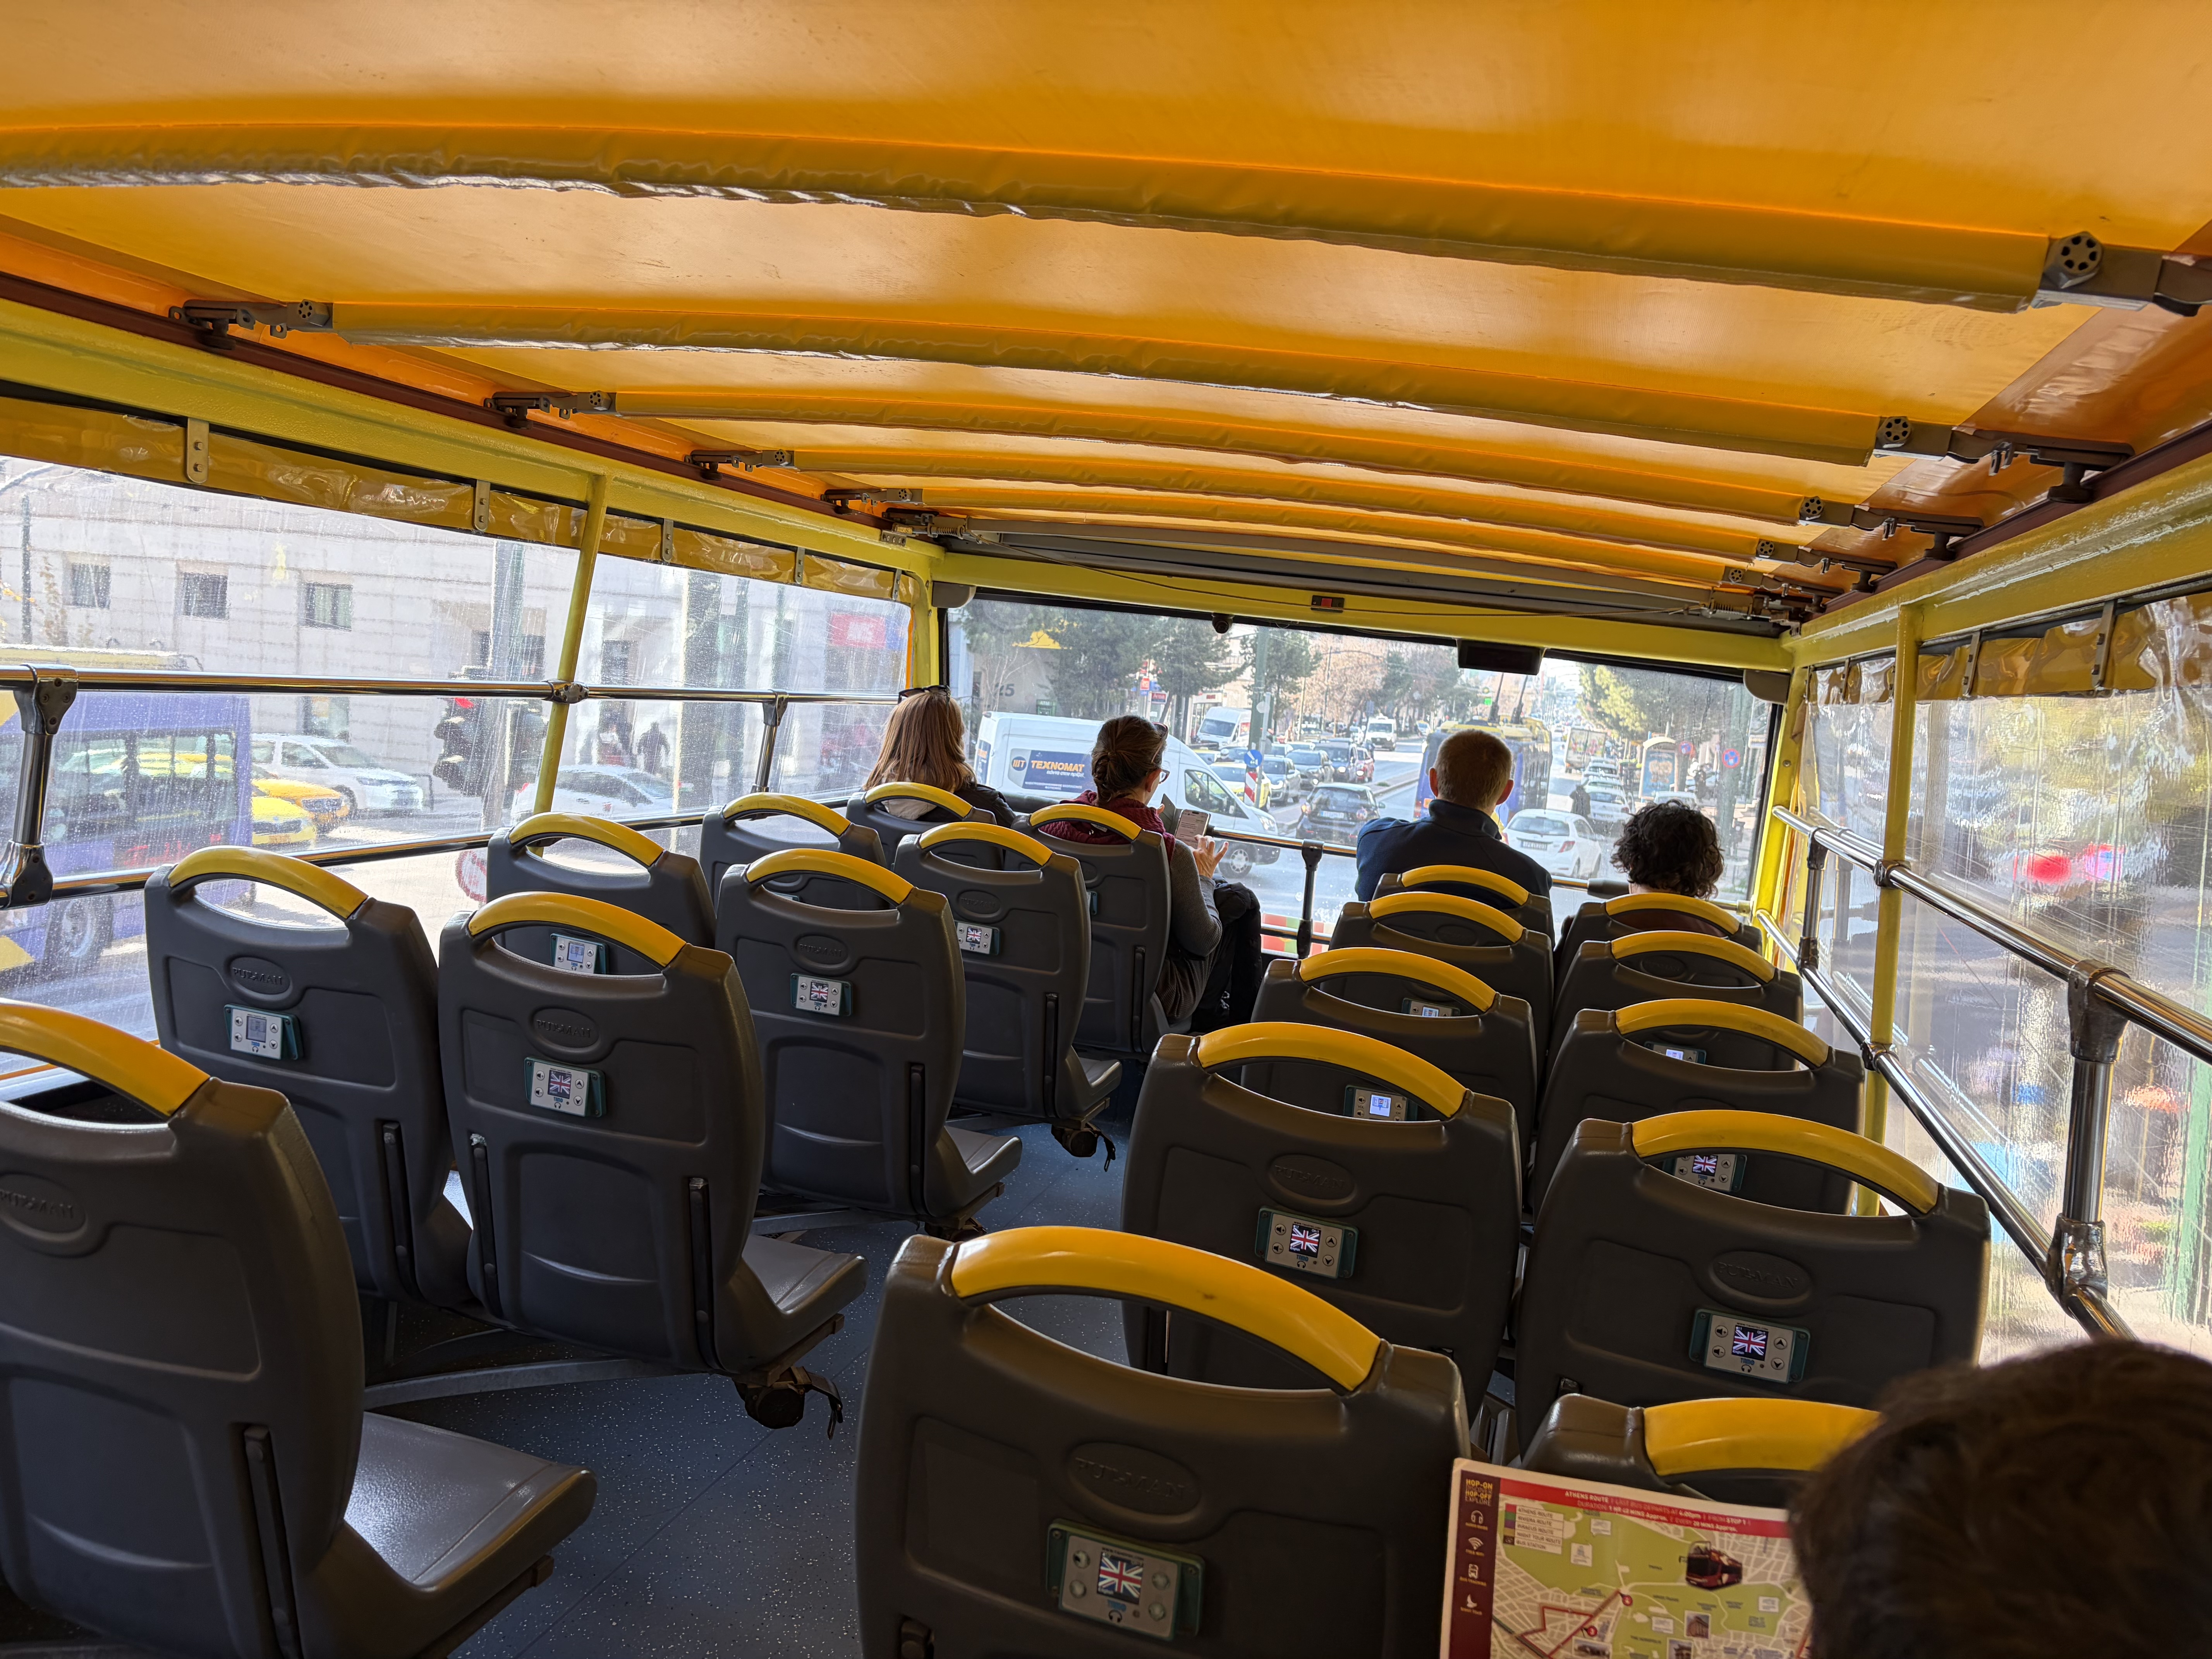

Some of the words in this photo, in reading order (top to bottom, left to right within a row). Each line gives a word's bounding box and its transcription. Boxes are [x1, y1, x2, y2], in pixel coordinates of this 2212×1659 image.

[994, 683, 1015, 697] 25
[1466, 1479, 1493, 1489] HOP-ON
[1465, 1490, 1492, 1500] HOP-OFF
[1565, 1491, 1589, 1500] ATHENS
[1589, 1494, 1608, 1503] ROUTE
[1465, 1496, 1491, 1506] EXPLORE
[1518, 1506, 1537, 1515] ATHENS
[1517, 1523, 1538, 1532] PIRAEUS
[1527, 1540, 1546, 1549] STATION
[1532, 1534, 1545, 1542] TOUR
[1545, 1536, 1561, 1545] ROUTE
